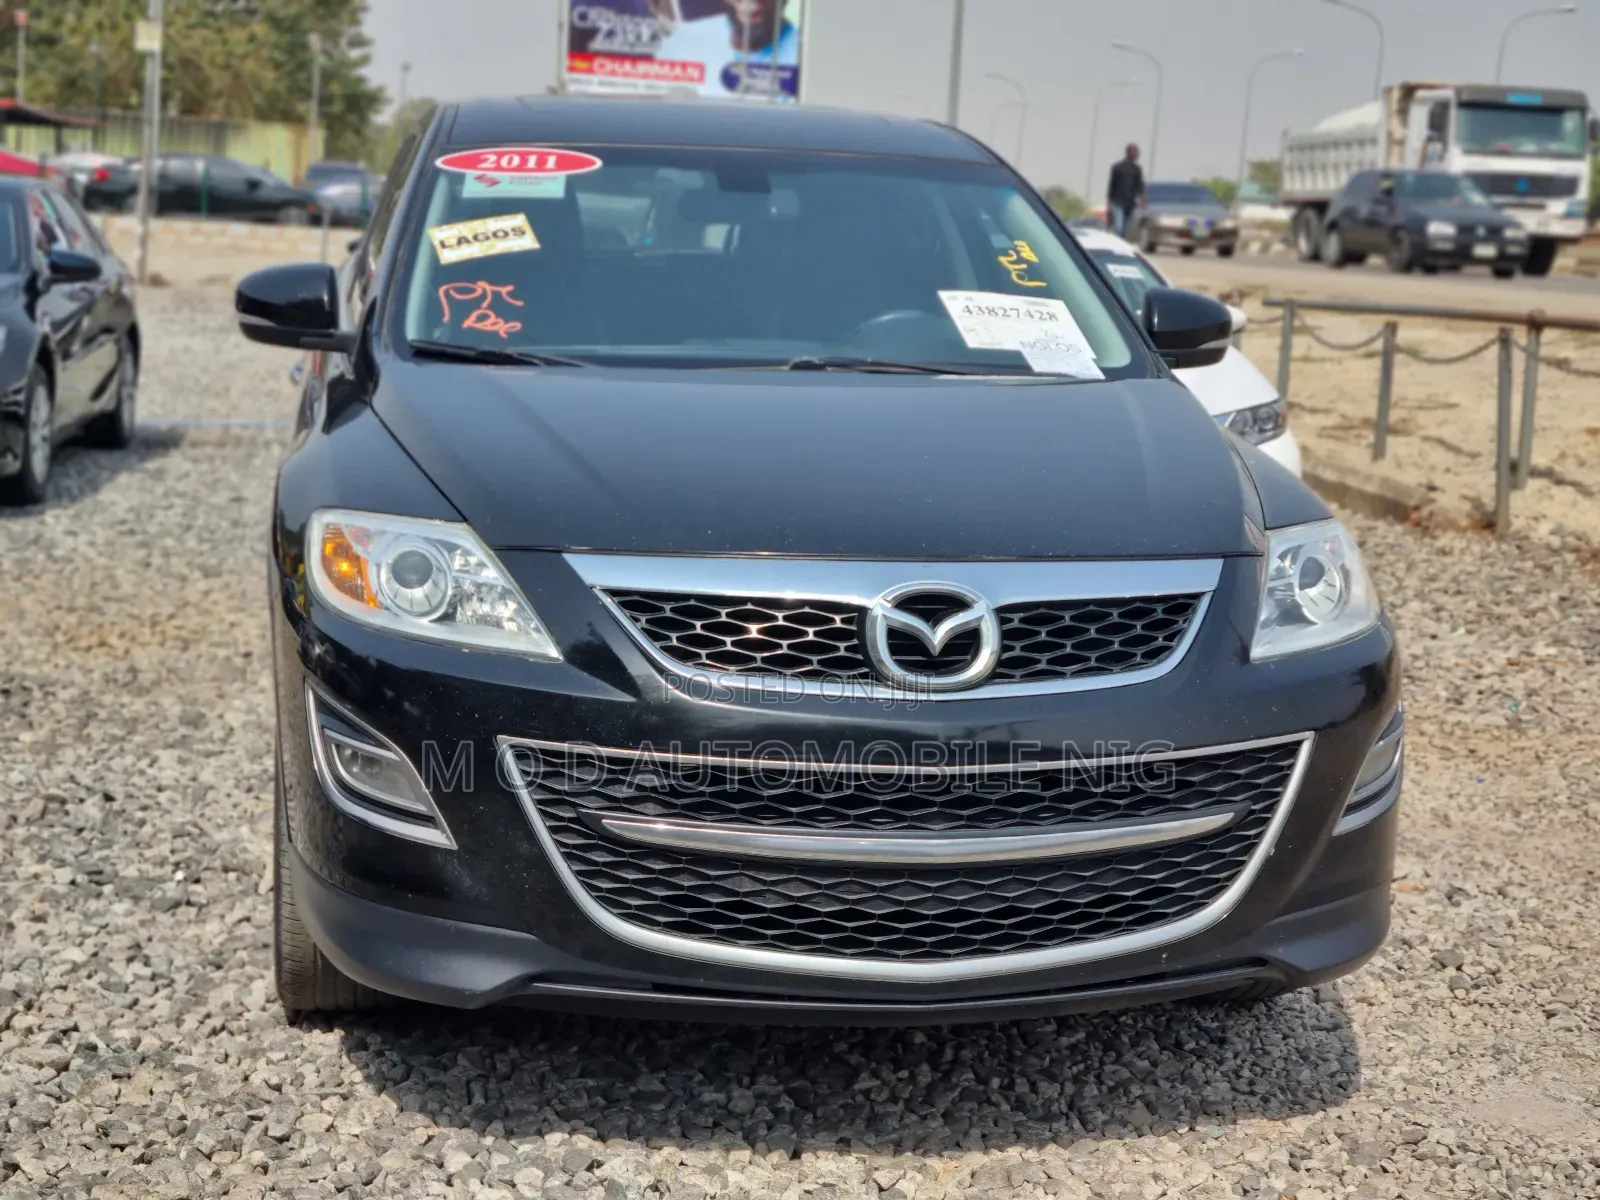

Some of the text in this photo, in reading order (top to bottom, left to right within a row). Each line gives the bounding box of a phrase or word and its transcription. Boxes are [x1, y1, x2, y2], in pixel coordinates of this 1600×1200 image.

[477, 153, 558, 169] 2011
[439, 225, 527, 249] LAGOS
[962, 305, 1059, 322] 43827428
